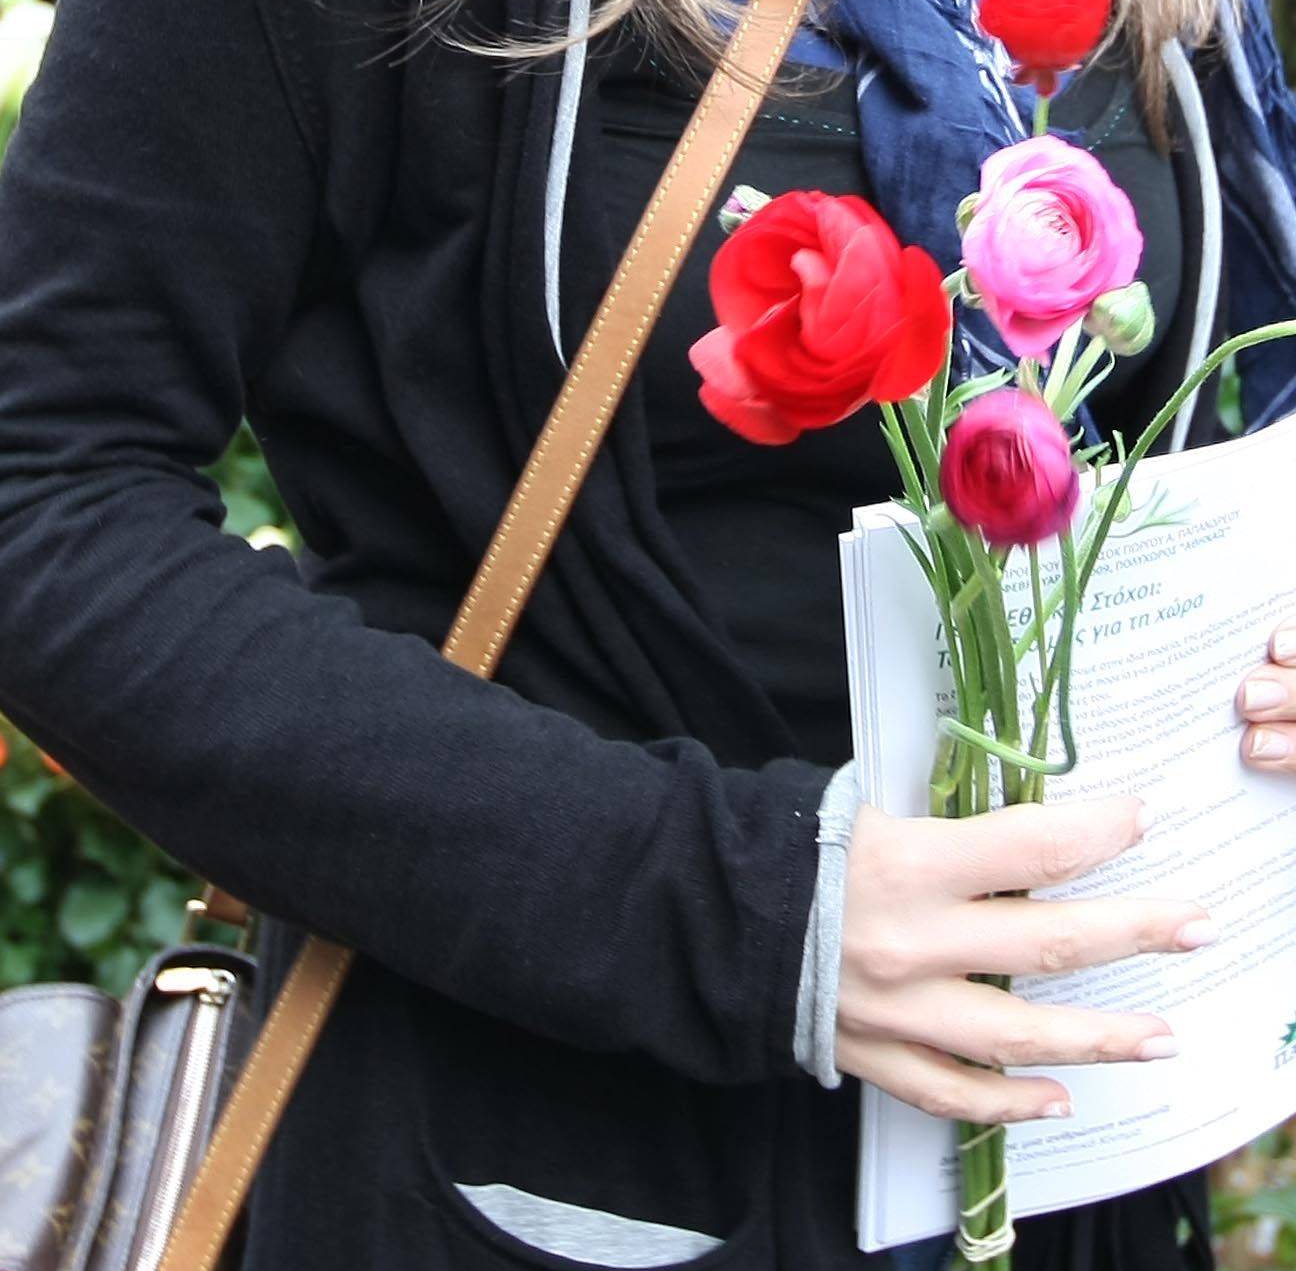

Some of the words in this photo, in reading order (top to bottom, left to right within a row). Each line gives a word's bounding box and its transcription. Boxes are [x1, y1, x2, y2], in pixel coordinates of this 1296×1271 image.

[1090, 581, 1163, 612] Στόχοι:
[1093, 620, 1122, 646] για
[1129, 612, 1150, 631] τη
[1153, 592, 1204, 626] χώρα
